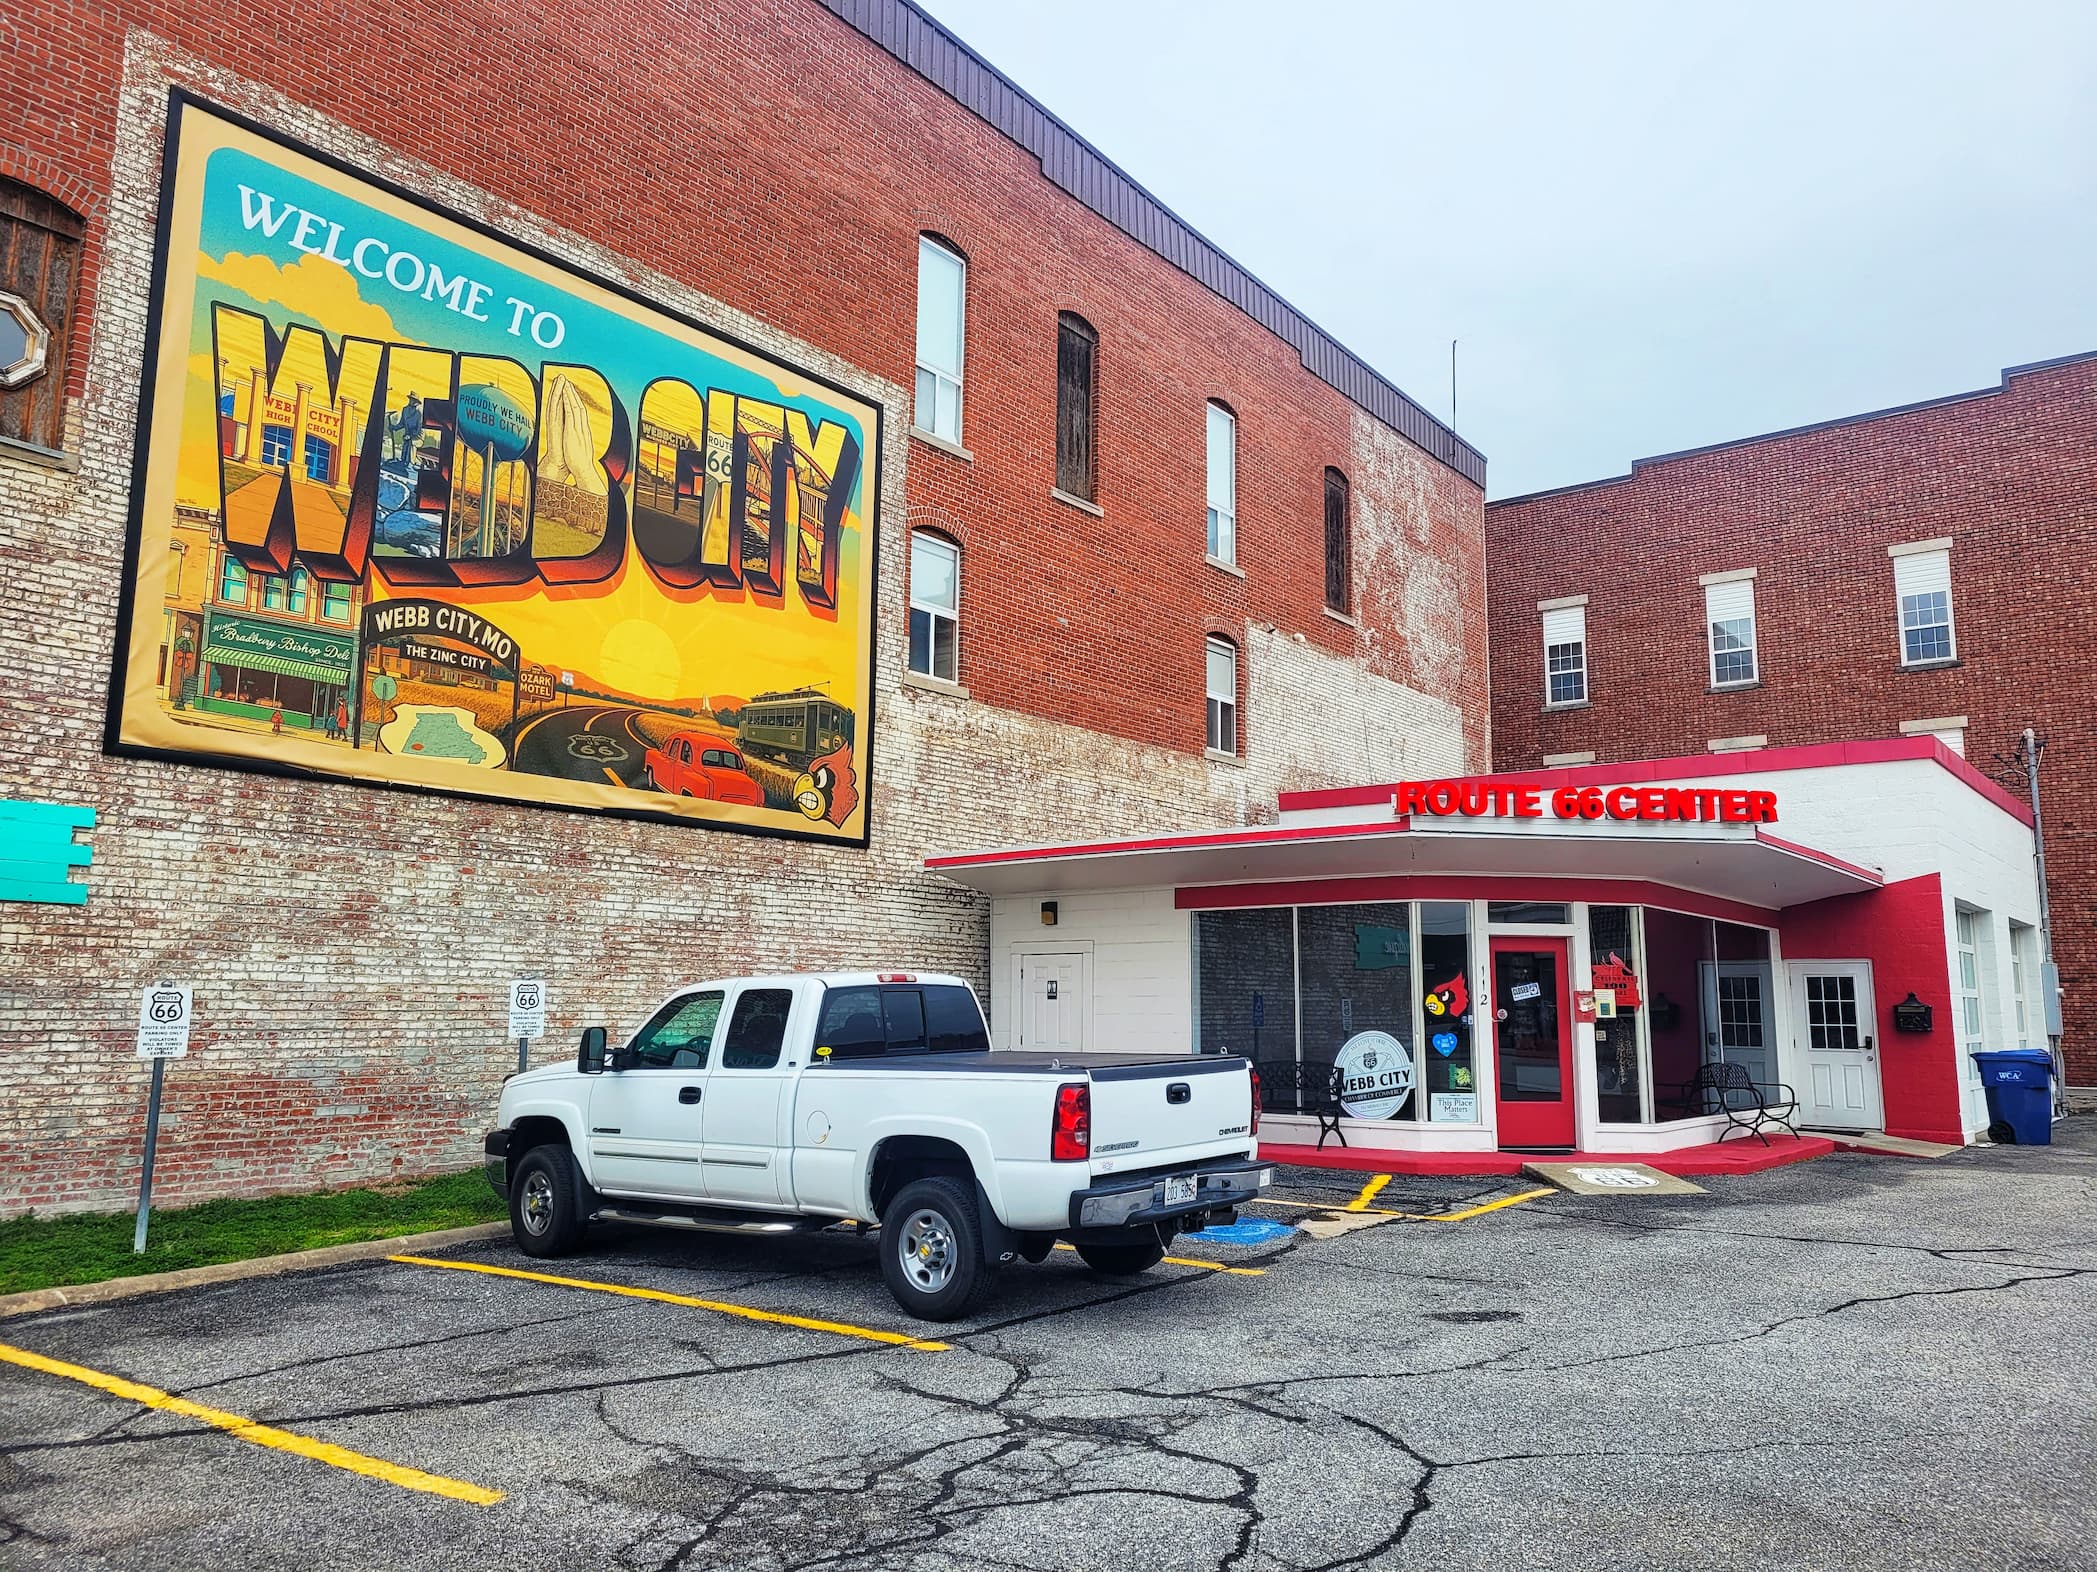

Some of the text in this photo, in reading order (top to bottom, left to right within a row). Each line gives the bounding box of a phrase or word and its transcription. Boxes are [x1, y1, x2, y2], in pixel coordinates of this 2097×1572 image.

[237, 184, 566, 349] WELCOME TO
[266, 410, 338, 438] HIGH CHOOL
[309, 410, 340, 427] CITY
[466, 407, 523, 437] WEBB CITY
[501, 406, 513, 419] WE
[515, 413, 532, 429] HAIL
[708, 436, 733, 451] ROUTE
[211, 302, 859, 613] WEBB CITY
[707, 450, 732, 477] 66
[375, 605, 430, 633] WEBB
[220, 628, 351, 661] Bradbury Bishop Deli
[406, 644, 487, 671] THE ZINC CITY
[520, 674, 551, 686] OZARK
[519, 684, 551, 697] MOTEL
[580, 744, 614, 756] 66
[1392, 781, 1779, 823] ROUTE 66 CENTER
[519, 994, 536, 1006] 66
[155, 1004, 177, 1018] 66
[1365, 1059, 1376, 1067] 66
[1379, 1069, 1410, 1086] CITY
[1998, 1072, 2020, 1080] WCA
